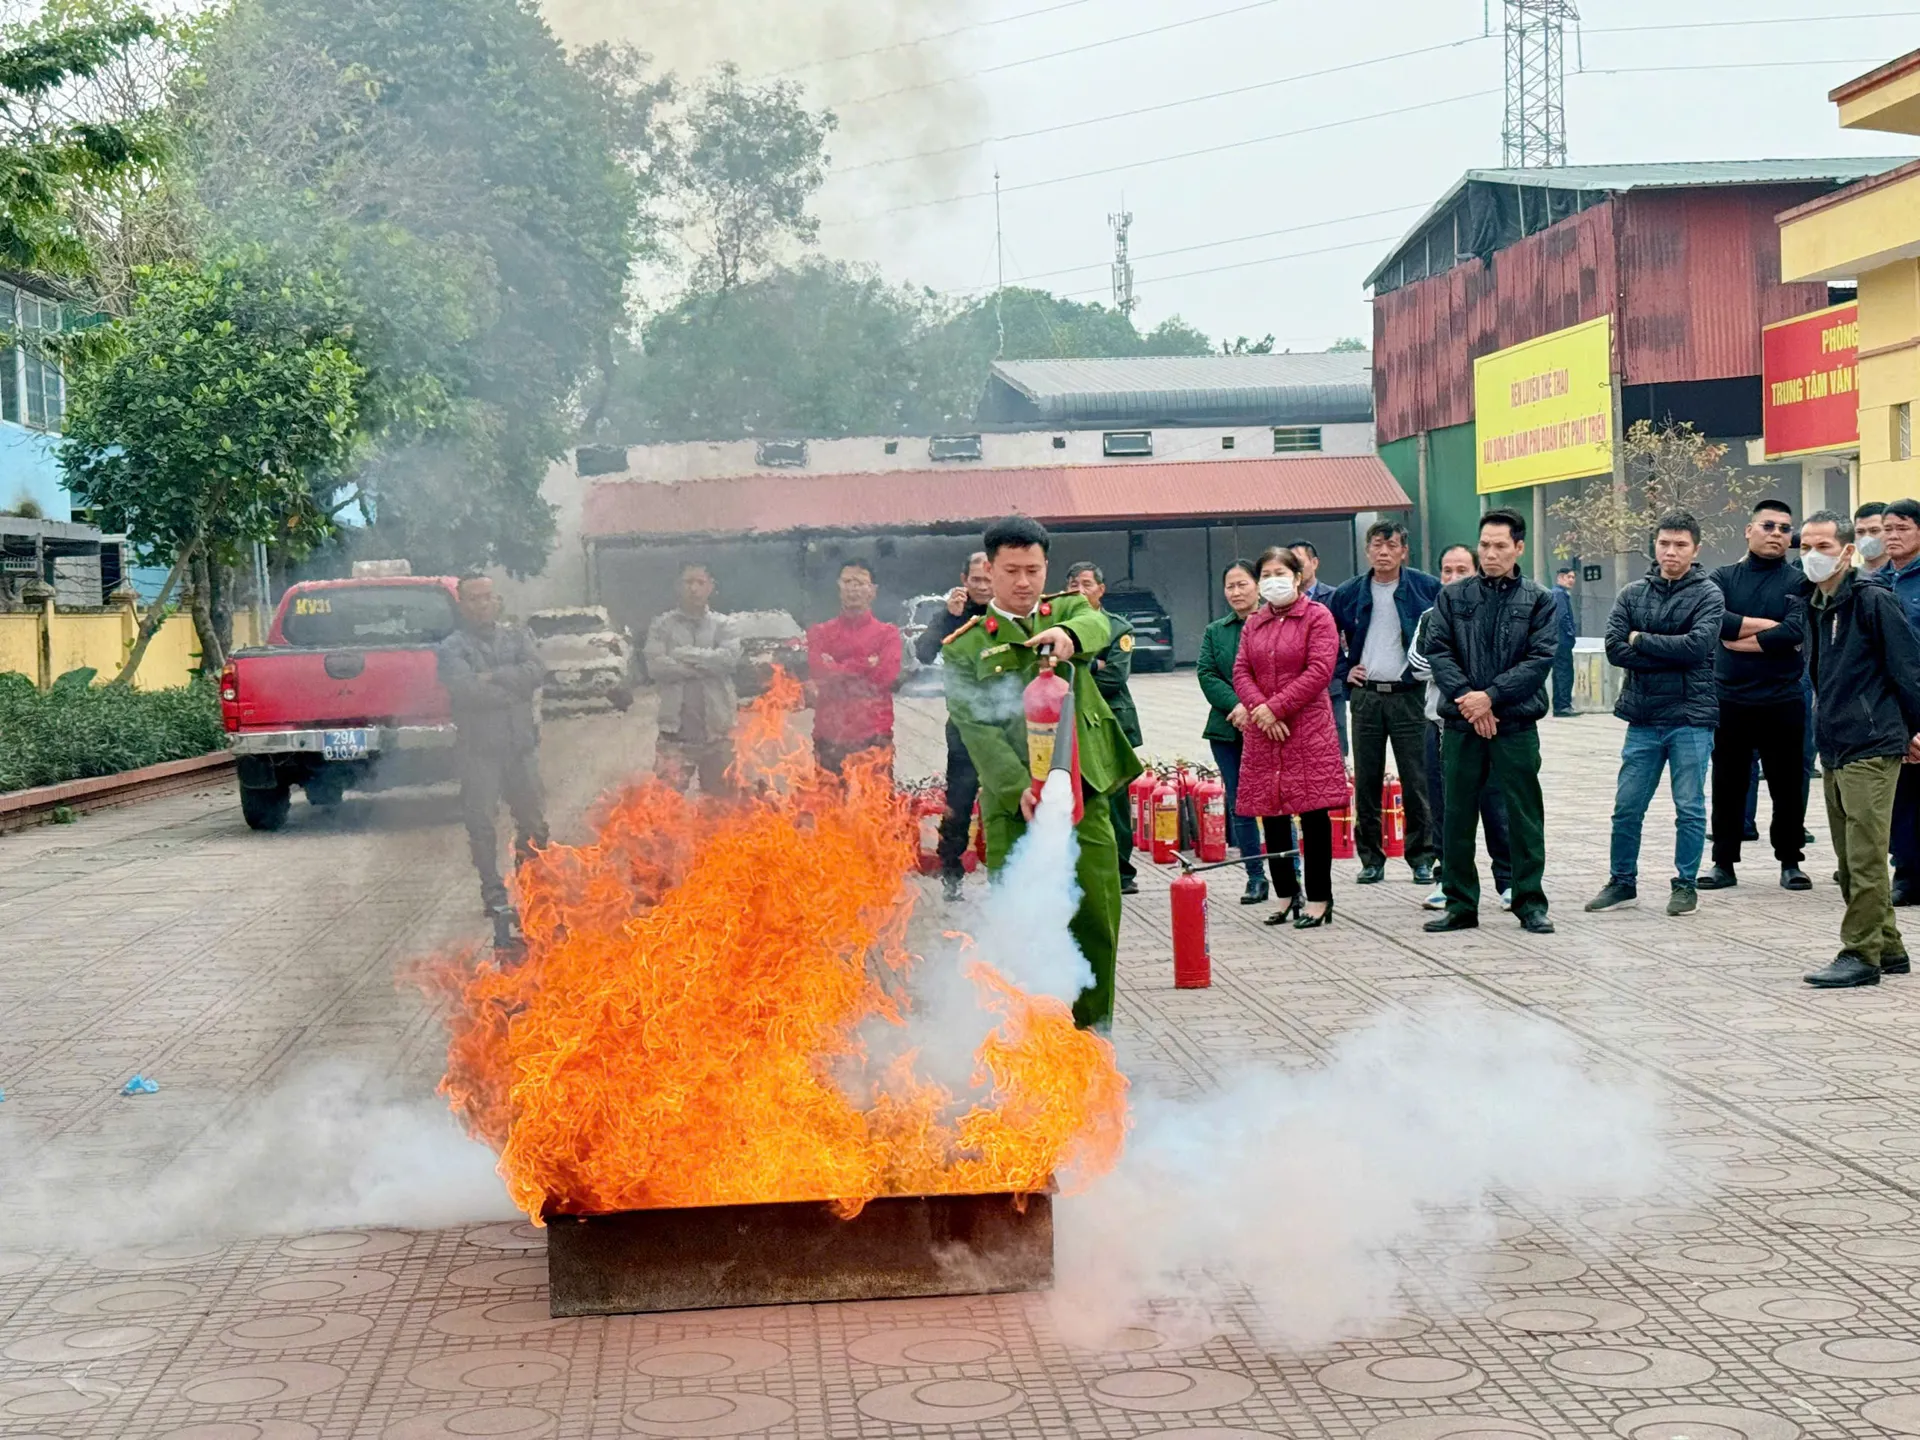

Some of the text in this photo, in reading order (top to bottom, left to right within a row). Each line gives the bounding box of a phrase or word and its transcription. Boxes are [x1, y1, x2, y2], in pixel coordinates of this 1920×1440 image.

[1822, 319, 1859, 355] PHÒNG
[1771, 377, 1803, 406] TRUNG
[1804, 369, 1827, 400] TÂM
[1829, 363, 1852, 395] VĂN
[333, 730, 356, 745] 29A
